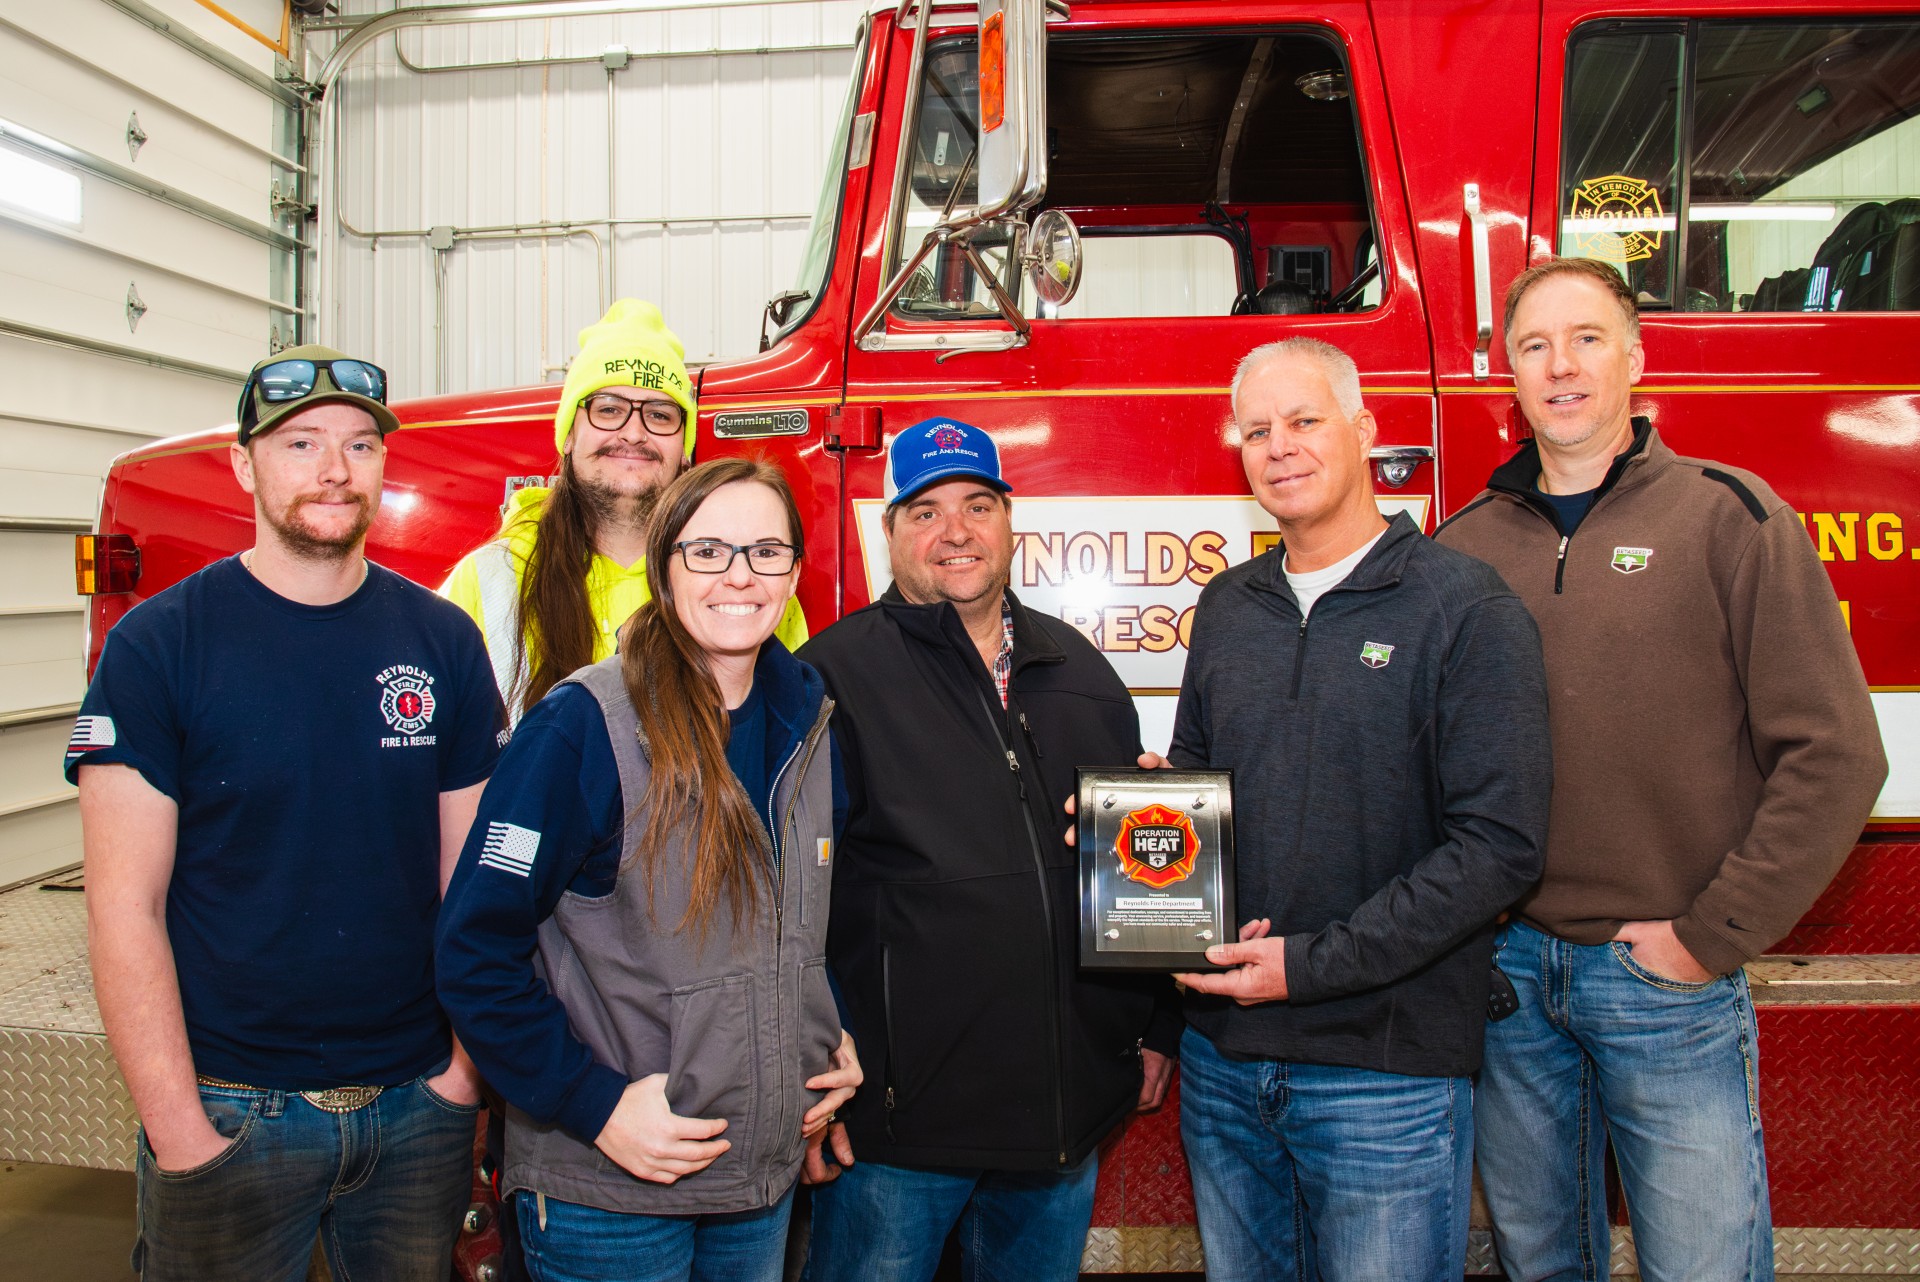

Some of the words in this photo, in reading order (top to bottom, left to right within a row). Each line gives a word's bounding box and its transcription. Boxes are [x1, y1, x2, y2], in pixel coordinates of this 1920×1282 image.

[1589, 189, 1600, 198] IN
[1602, 183, 1641, 195] MEMORY
[604, 359, 683, 391] REYNOLDS
[633, 371, 664, 389] FIRE
[718, 416, 772, 426] Cummins
[773, 413, 806, 431] L10
[924, 423, 968, 438] REYNOLDS
[1011, 530, 1229, 588] NOLDS
[1060, 604, 1198, 653] RES
[375, 664, 435, 685] REYNOLDS
[397, 681, 416, 689] FIRE
[402, 721, 419, 729] EMS
[381, 736, 401, 748] FIRE
[402, 736, 409, 746] &
[410, 735, 437, 747] RESCUE
[1134, 829, 1180, 837] OPERATION
[1134, 837, 1180, 852] HEAT
[1162, 900, 1196, 908] Department
